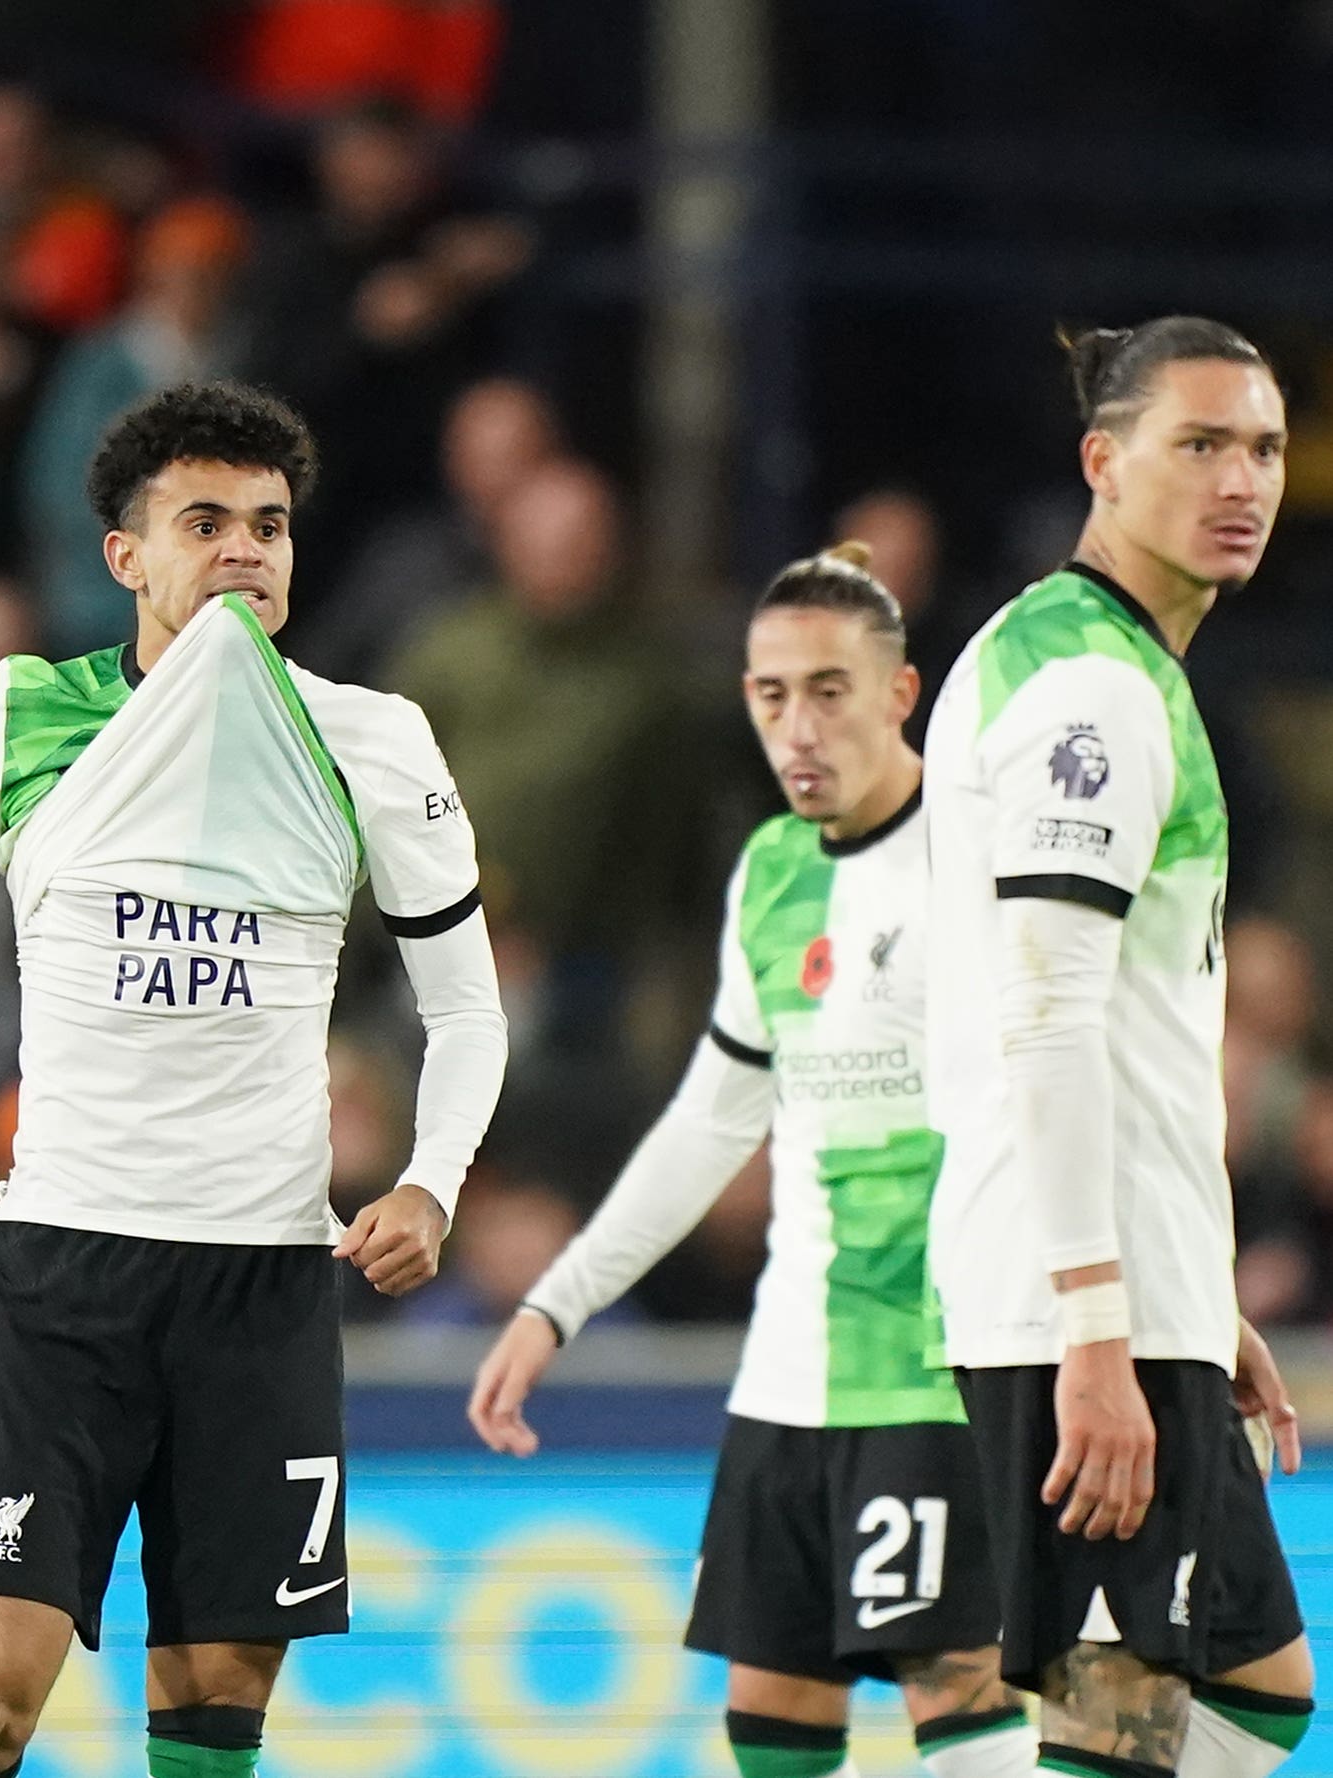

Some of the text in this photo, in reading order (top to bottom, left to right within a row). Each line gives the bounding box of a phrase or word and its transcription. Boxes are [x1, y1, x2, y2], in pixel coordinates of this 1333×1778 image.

[115, 891, 261, 945] PARA
[114, 953, 254, 1007] PAPA
[285, 1455, 340, 1564] 7
[850, 1495, 949, 1599] 21
